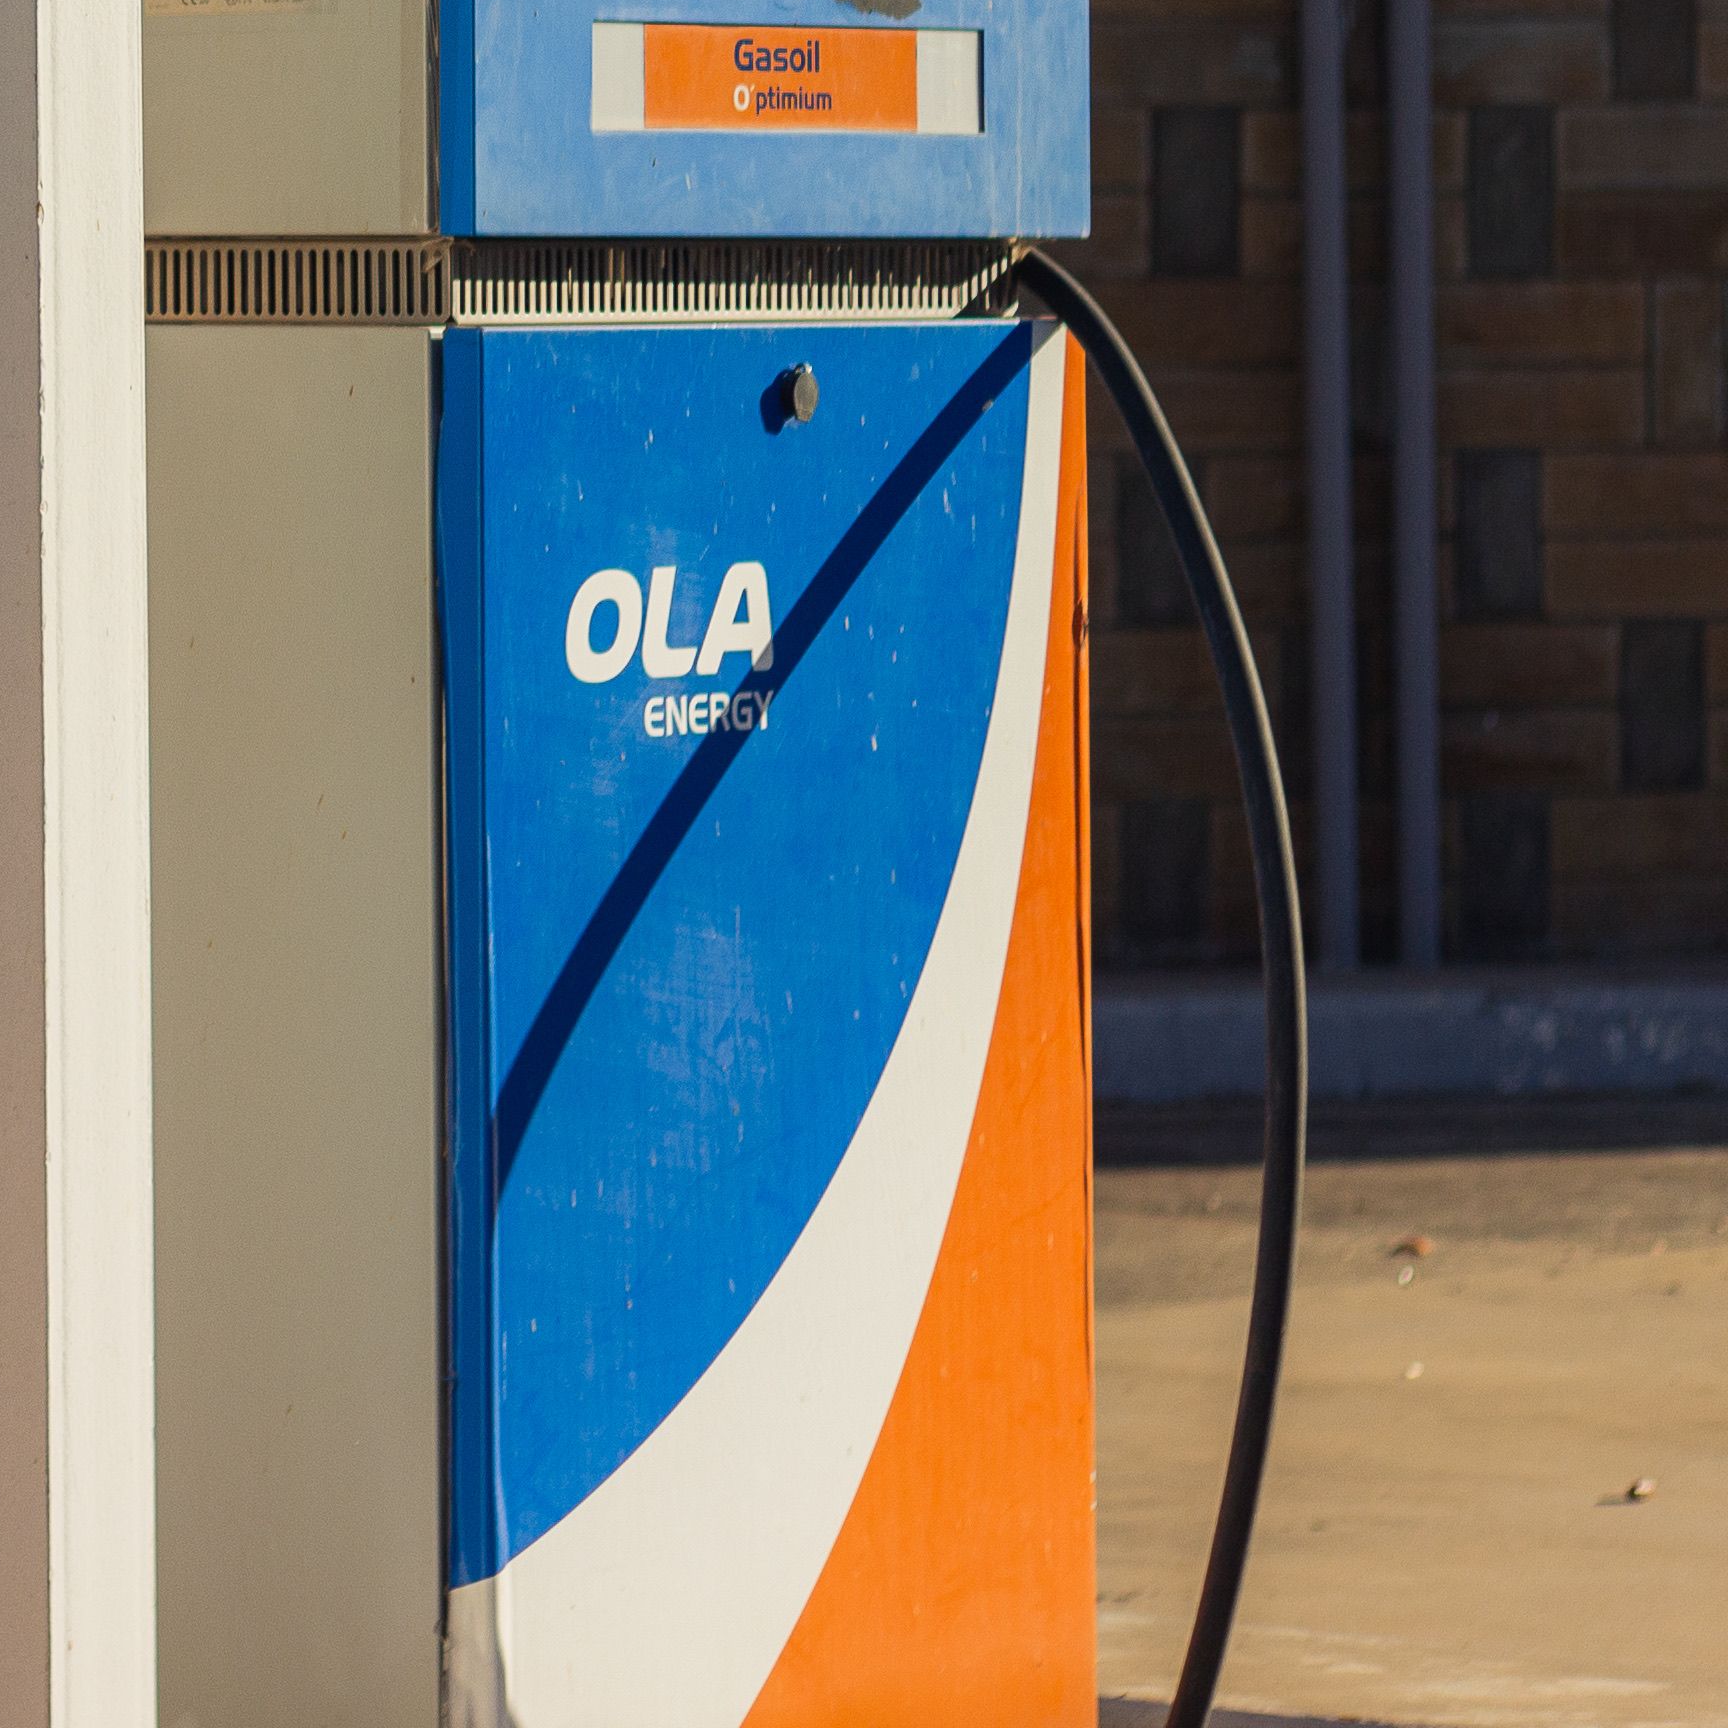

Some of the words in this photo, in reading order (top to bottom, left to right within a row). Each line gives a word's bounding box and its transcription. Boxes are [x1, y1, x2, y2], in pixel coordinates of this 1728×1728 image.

[734, 38, 820, 73] Gasoil
[565, 561, 775, 685] OLA
[644, 690, 775, 738] ENERGY
